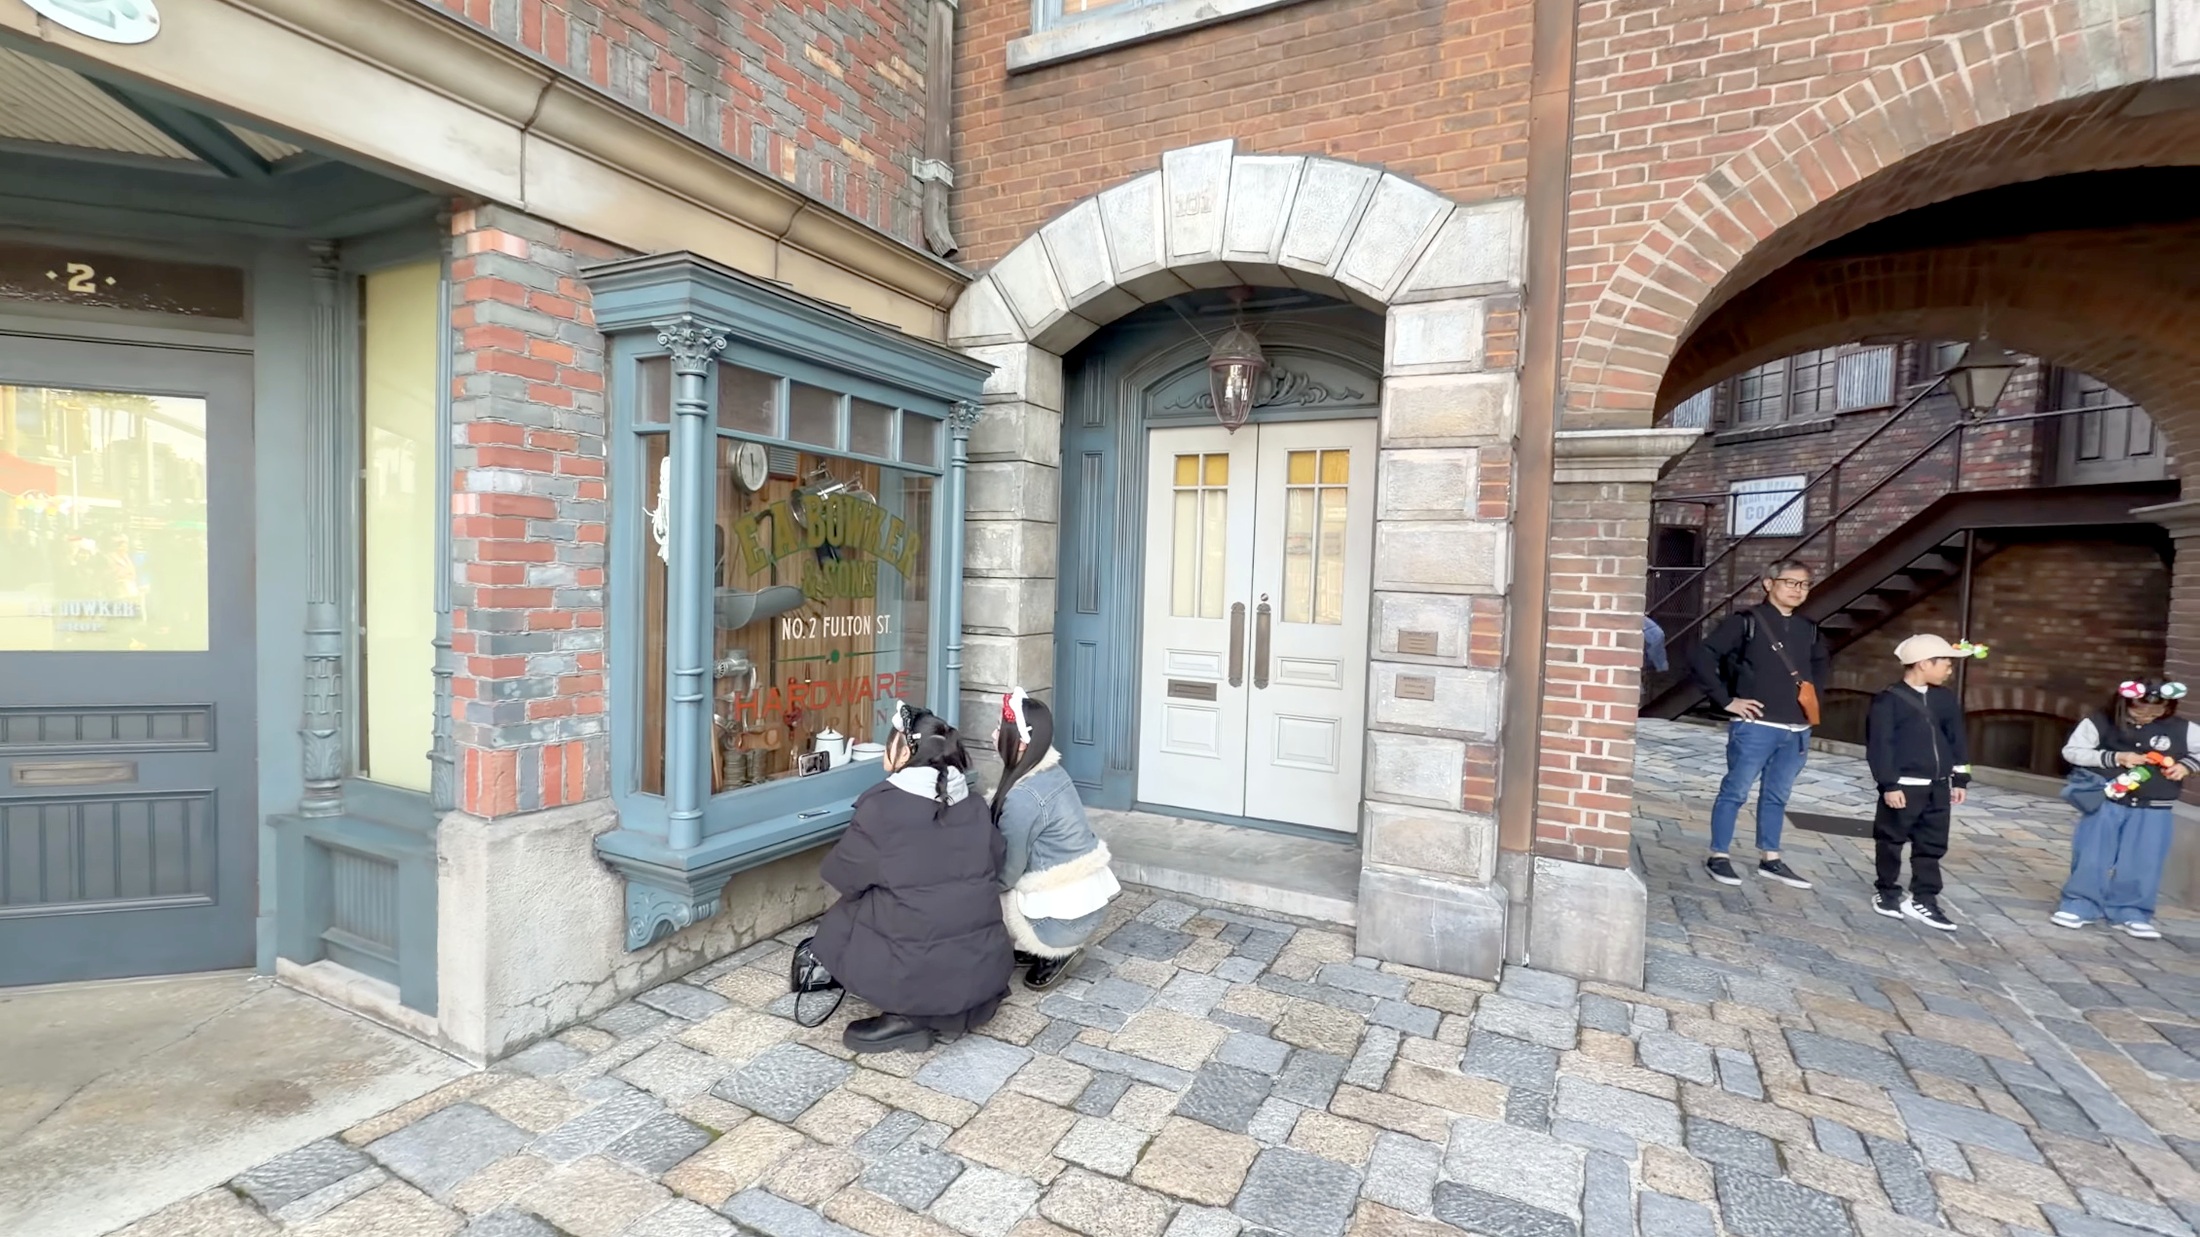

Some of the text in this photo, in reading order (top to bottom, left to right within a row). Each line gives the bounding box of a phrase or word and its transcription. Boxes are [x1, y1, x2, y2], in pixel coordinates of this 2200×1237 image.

[823, 560, 877, 598] SONS
[823, 615, 871, 638] FULTON
[877, 614, 893, 634] ST.
[734, 670, 911, 722] HARDWARE
